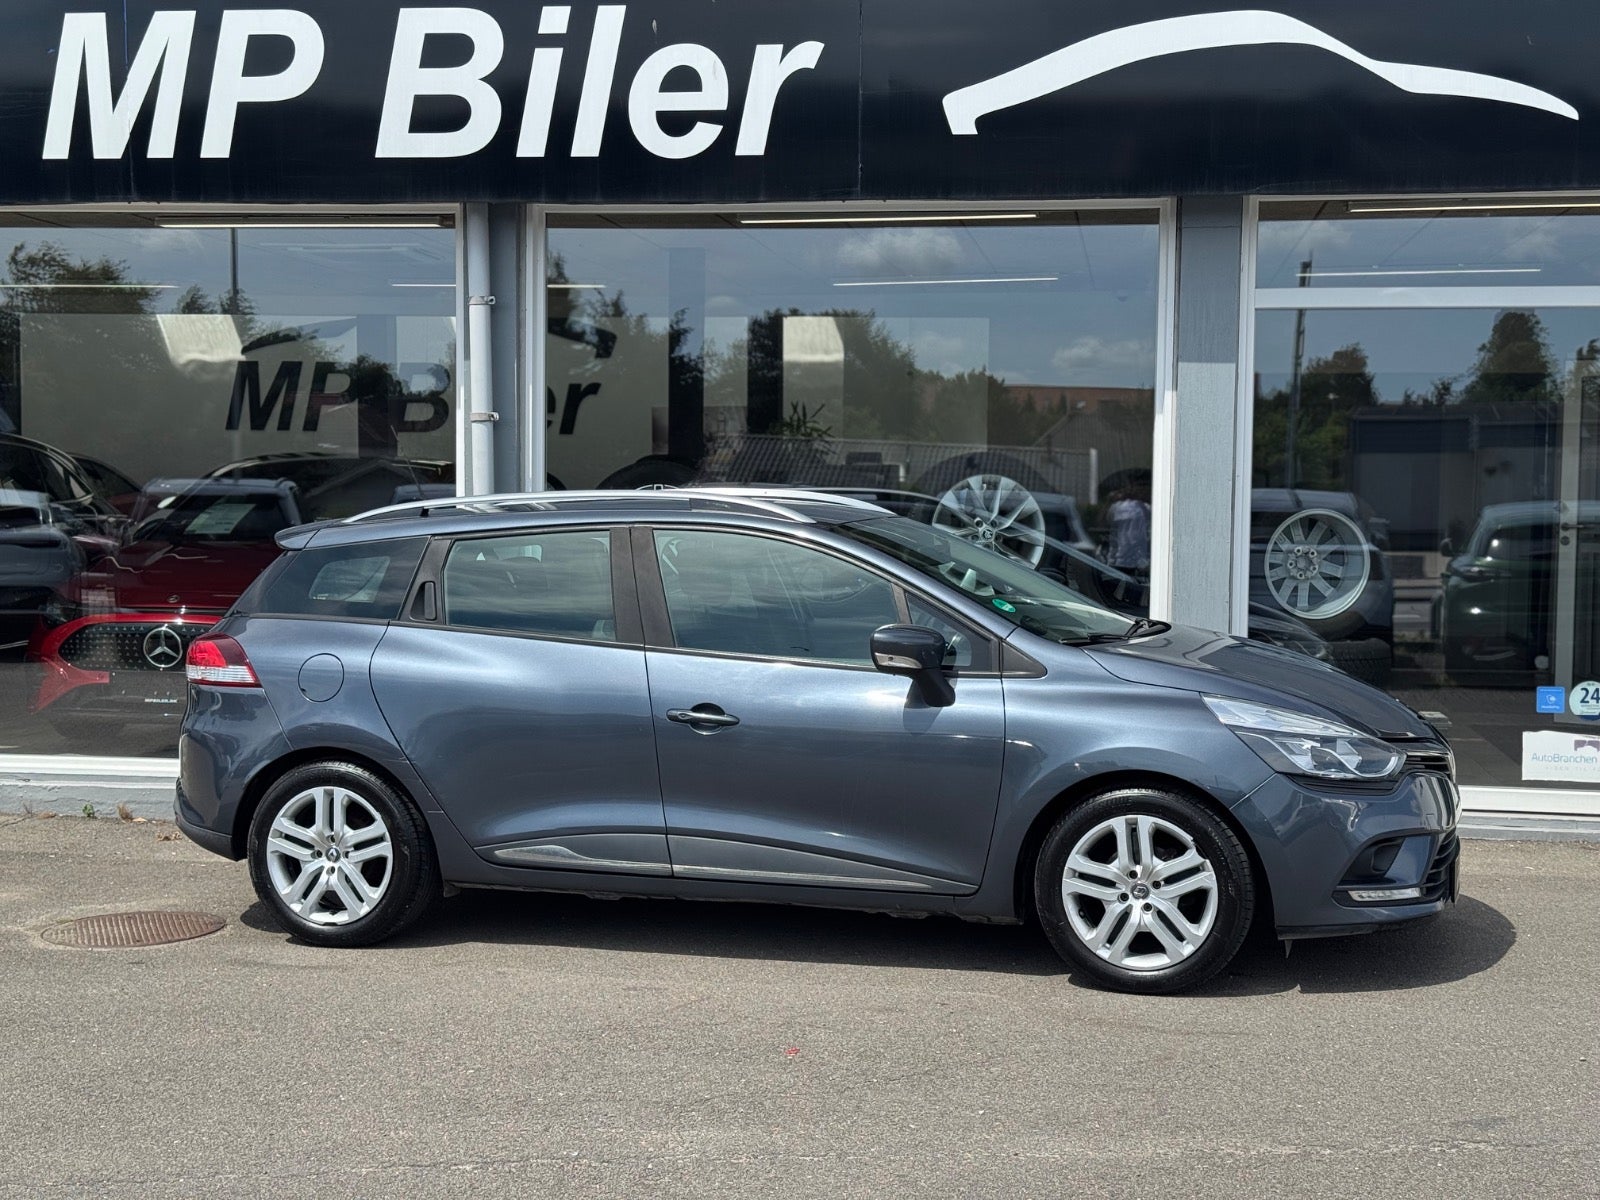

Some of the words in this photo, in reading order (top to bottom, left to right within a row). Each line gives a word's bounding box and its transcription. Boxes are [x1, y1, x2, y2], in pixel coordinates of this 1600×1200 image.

[42, 9, 325, 160] MP
[375, 4, 825, 159] Biler
[225, 360, 354, 432] MP
[1531, 753, 1598, 764] AutoBranchen
